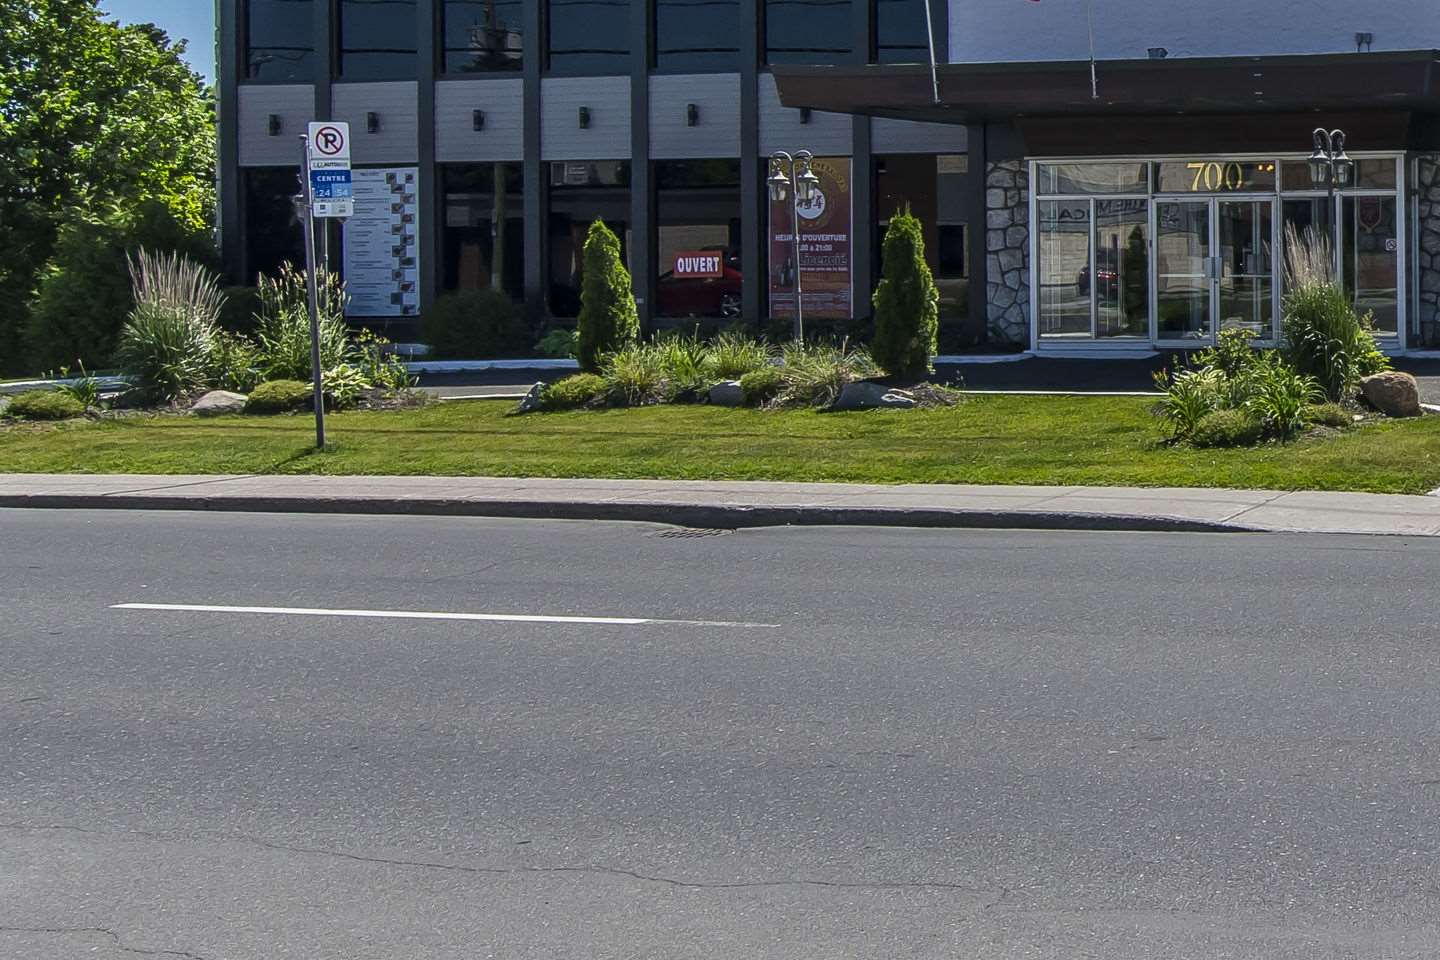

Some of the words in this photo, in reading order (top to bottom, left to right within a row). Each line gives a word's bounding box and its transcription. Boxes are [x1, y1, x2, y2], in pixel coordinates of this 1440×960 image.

[1187, 162, 1242, 191] 700
[802, 233, 848, 242] D'OUVERTURE
[677, 256, 720, 273] OUVERT
